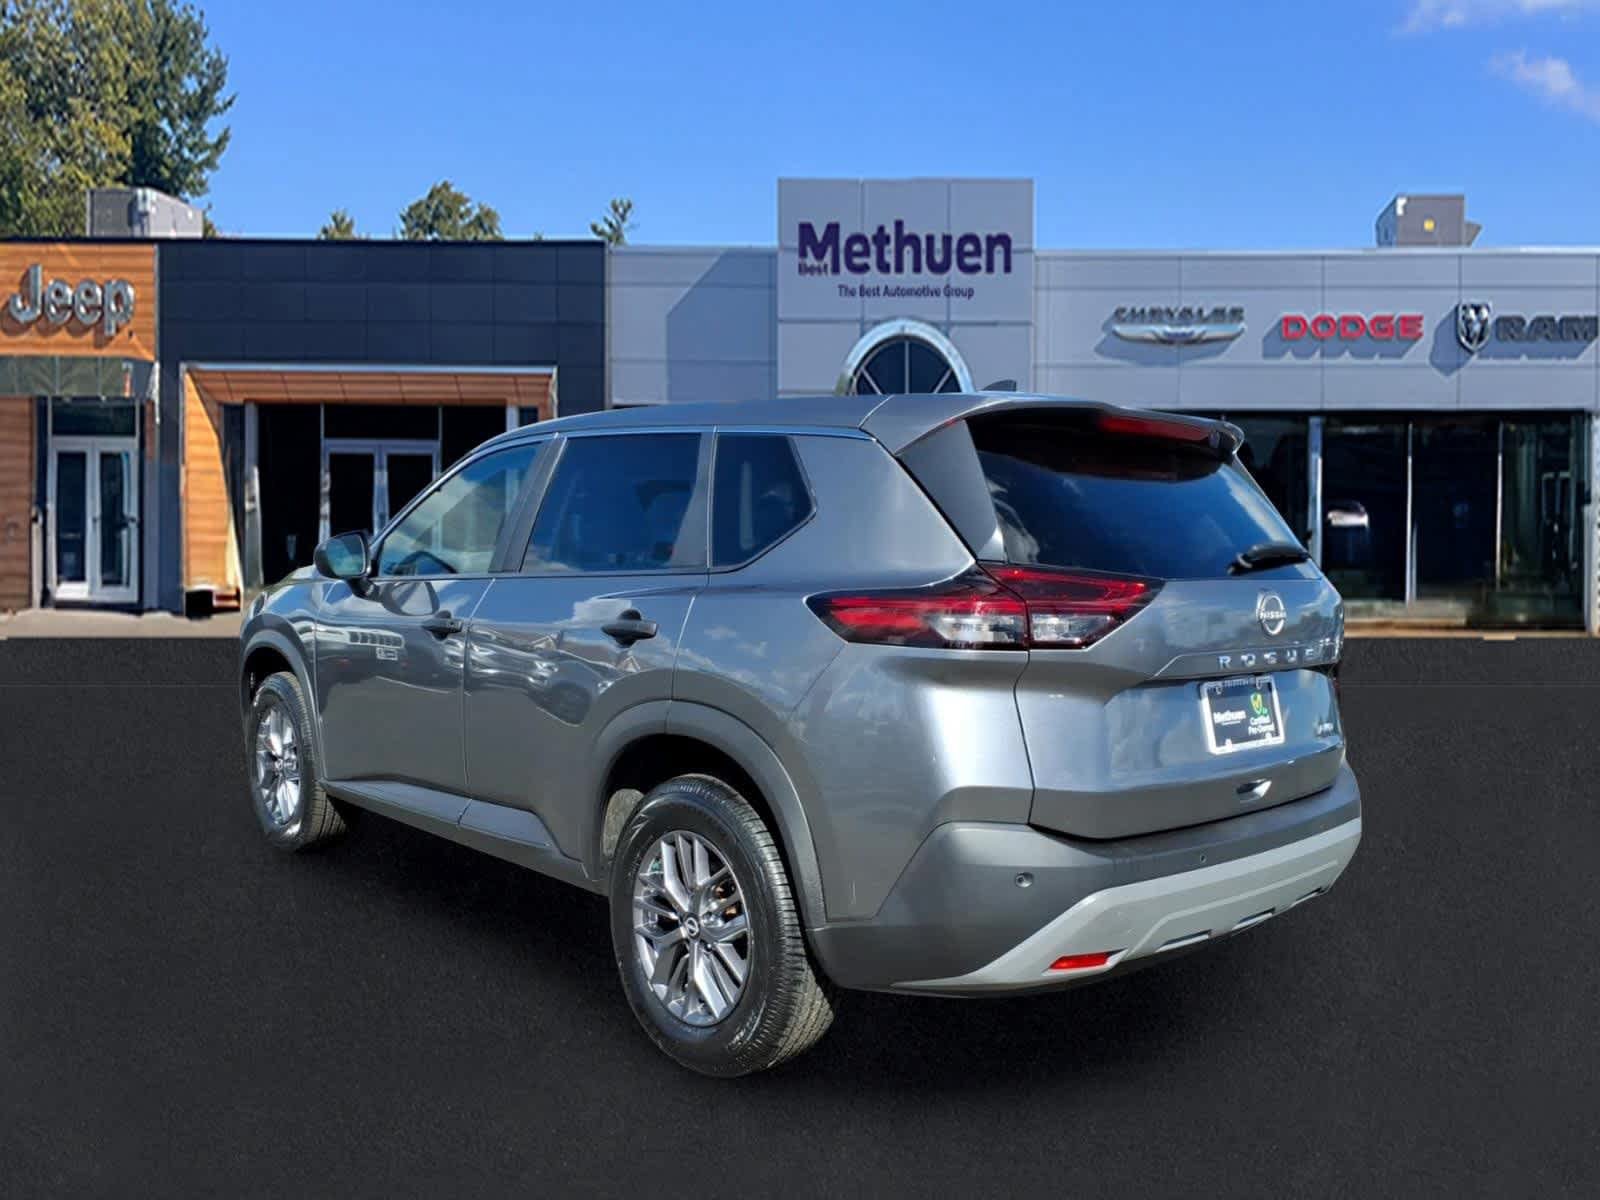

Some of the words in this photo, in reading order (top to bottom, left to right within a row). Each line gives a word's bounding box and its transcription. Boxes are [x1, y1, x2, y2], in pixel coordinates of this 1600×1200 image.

[798, 219, 1013, 275] Methuen
[9, 263, 135, 336] Jeep
[838, 284, 857, 297] The
[859, 284, 879, 297] Best
[883, 284, 941, 297] Automotive
[943, 284, 975, 300] Group
[1281, 313, 1424, 341] DODGE
[1495, 315, 1599, 343] RAM
[1219, 648, 1315, 668] ROGUE
